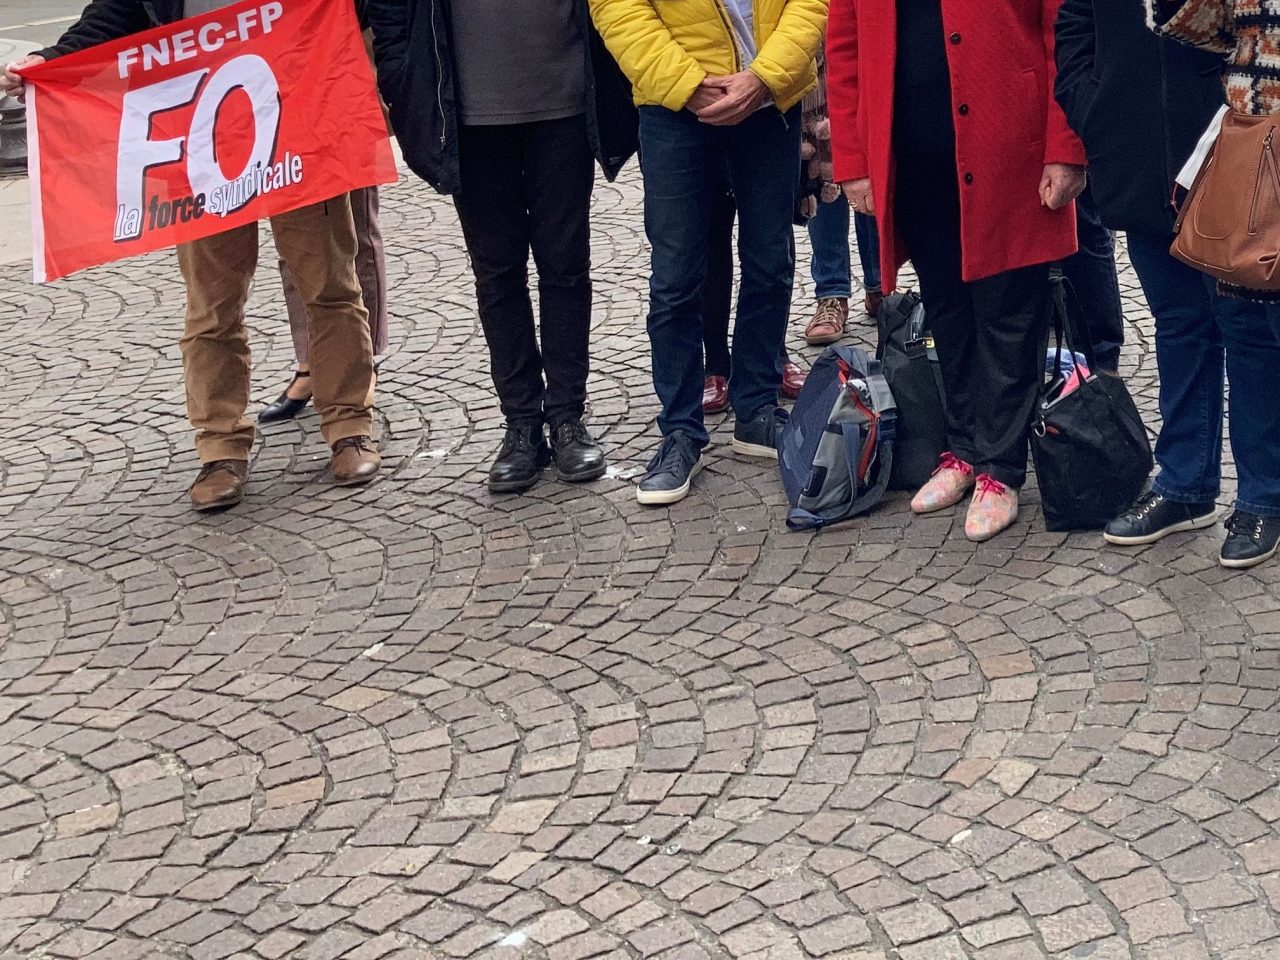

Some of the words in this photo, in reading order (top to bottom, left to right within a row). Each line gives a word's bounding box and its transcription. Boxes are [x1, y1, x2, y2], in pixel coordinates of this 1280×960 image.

[116, 1, 284, 80] FNEC-FP
[114, 54, 282, 242] FO
[114, 204, 139, 238] la
[149, 192, 206, 231] force
[208, 151, 303, 218] syndicale
